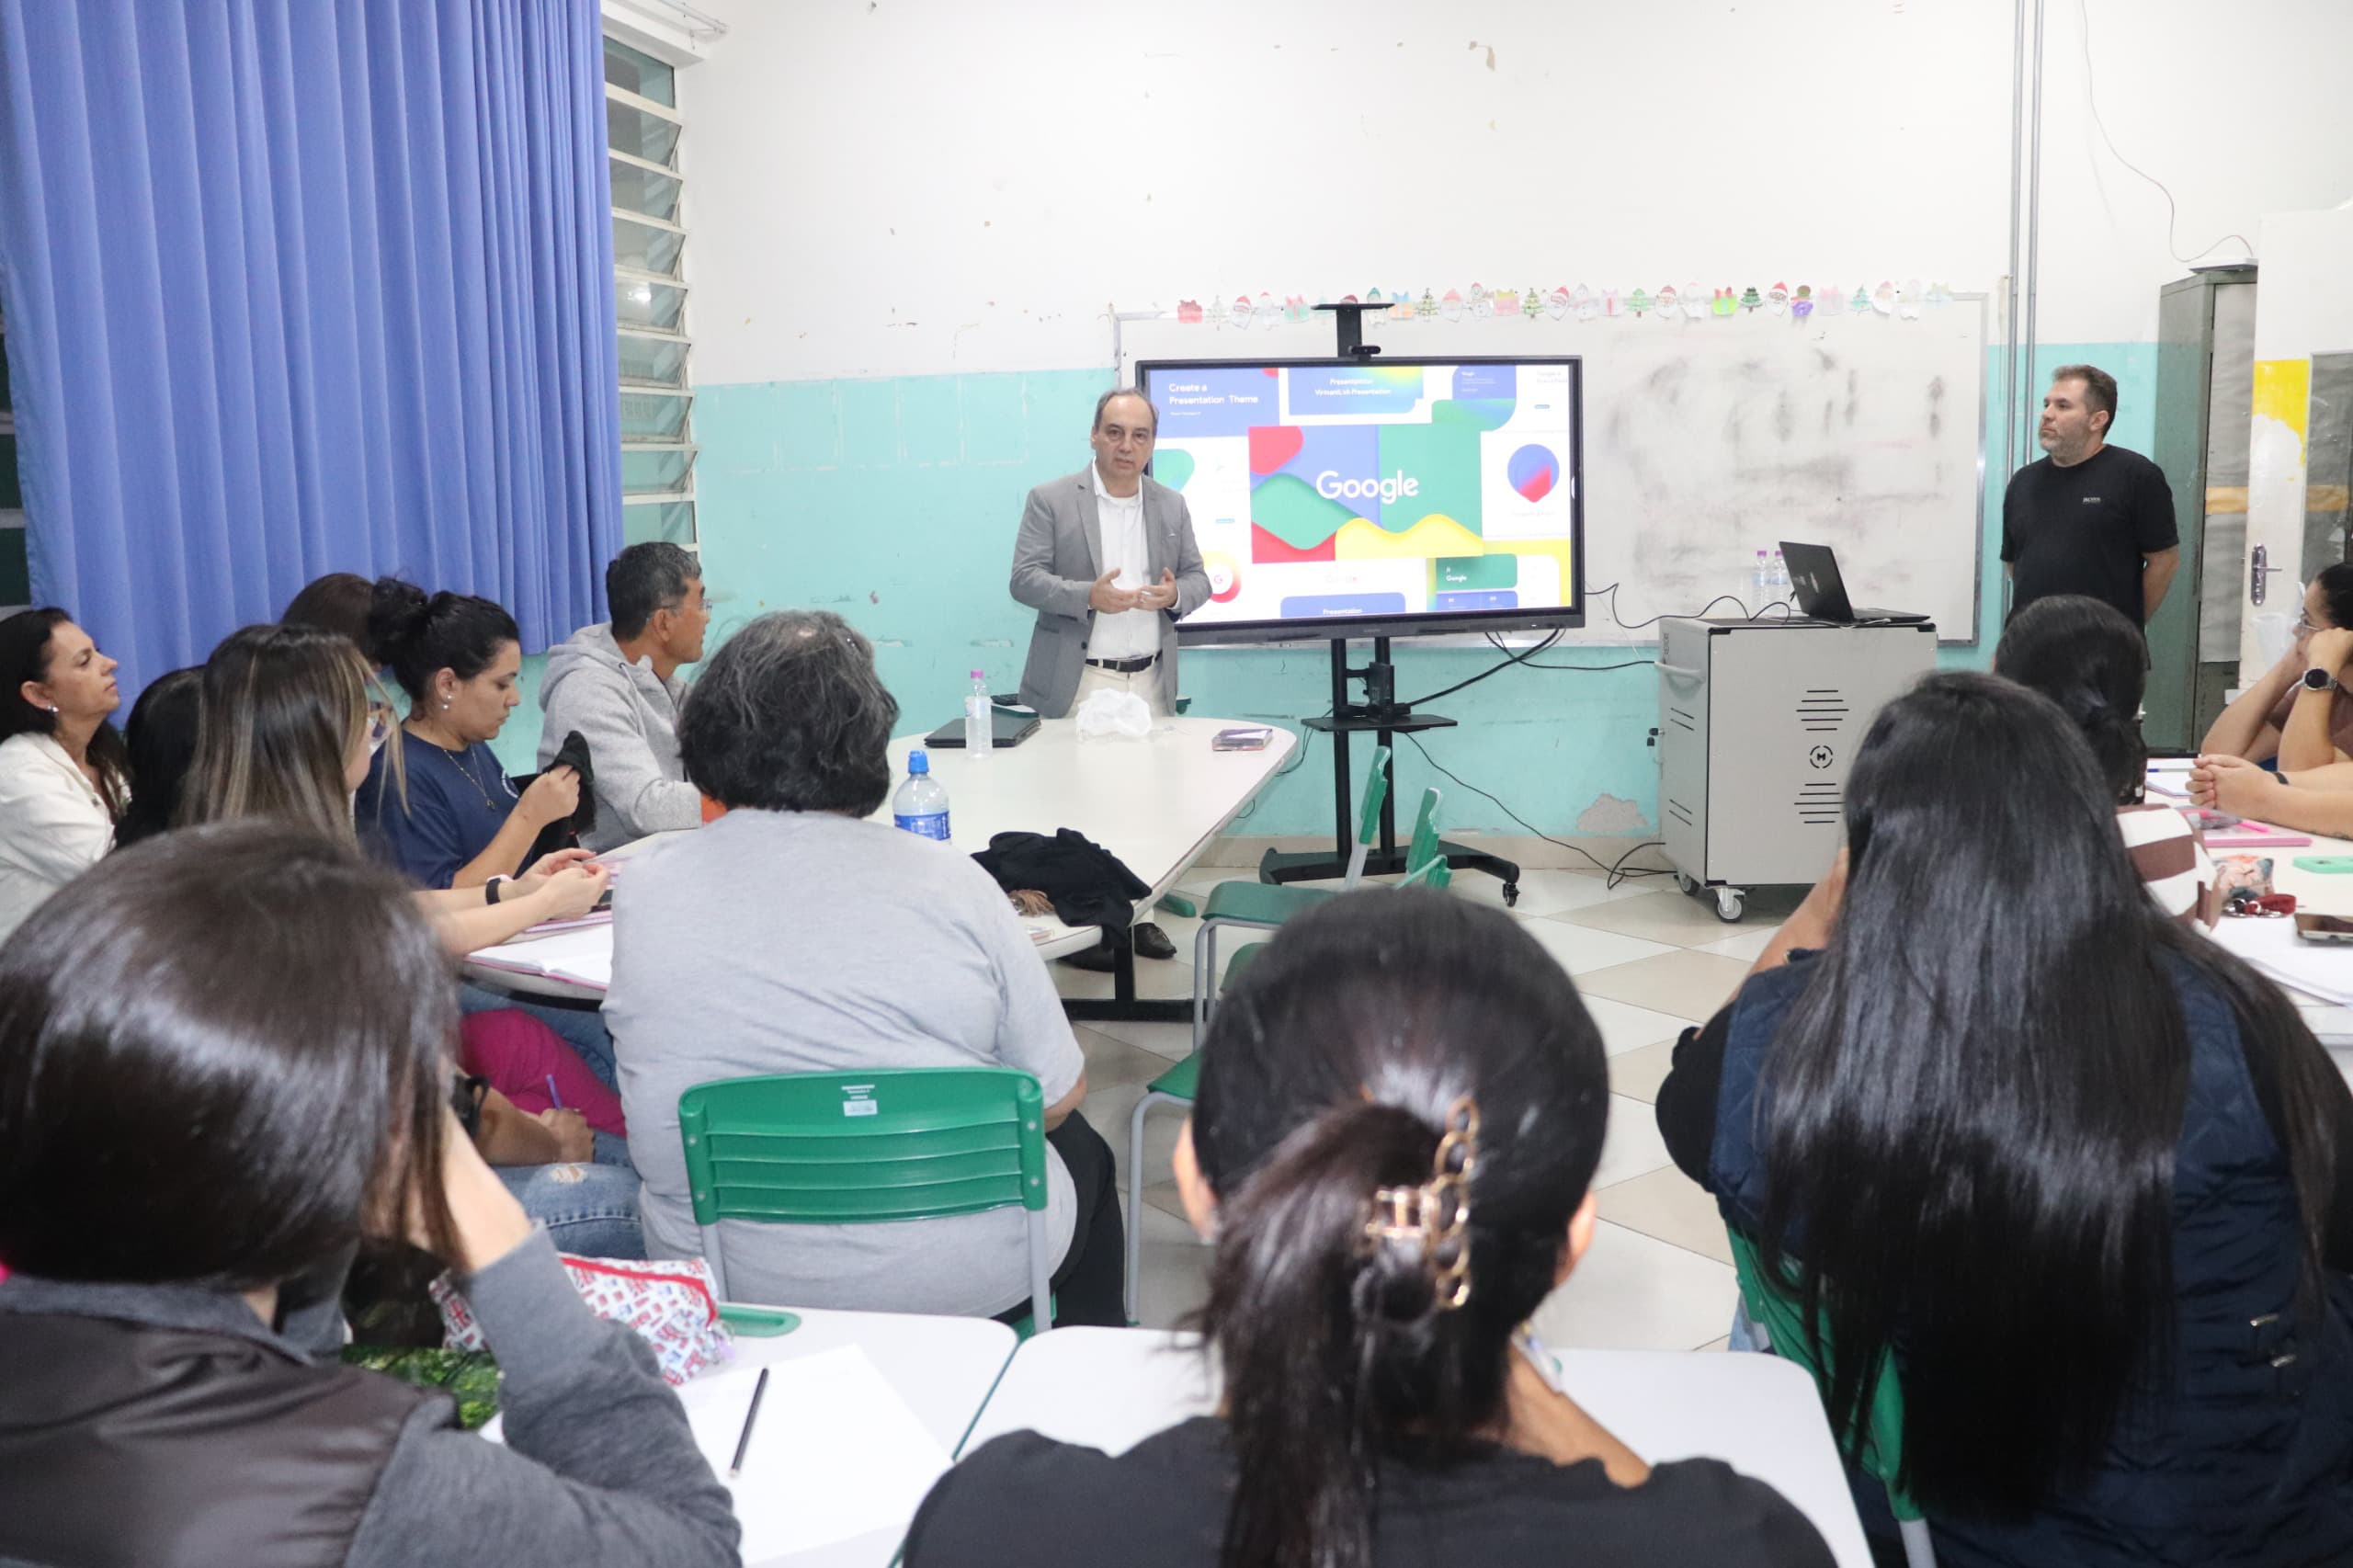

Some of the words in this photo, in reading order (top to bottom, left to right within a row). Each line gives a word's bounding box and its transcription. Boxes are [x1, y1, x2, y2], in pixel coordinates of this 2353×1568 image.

[1168, 382, 1200, 392] Create
[1168, 395, 1224, 404] Presentation
[1228, 394, 1258, 403] Theme
[1315, 470, 1419, 505] Google
[1446, 574, 1468, 583] Google
